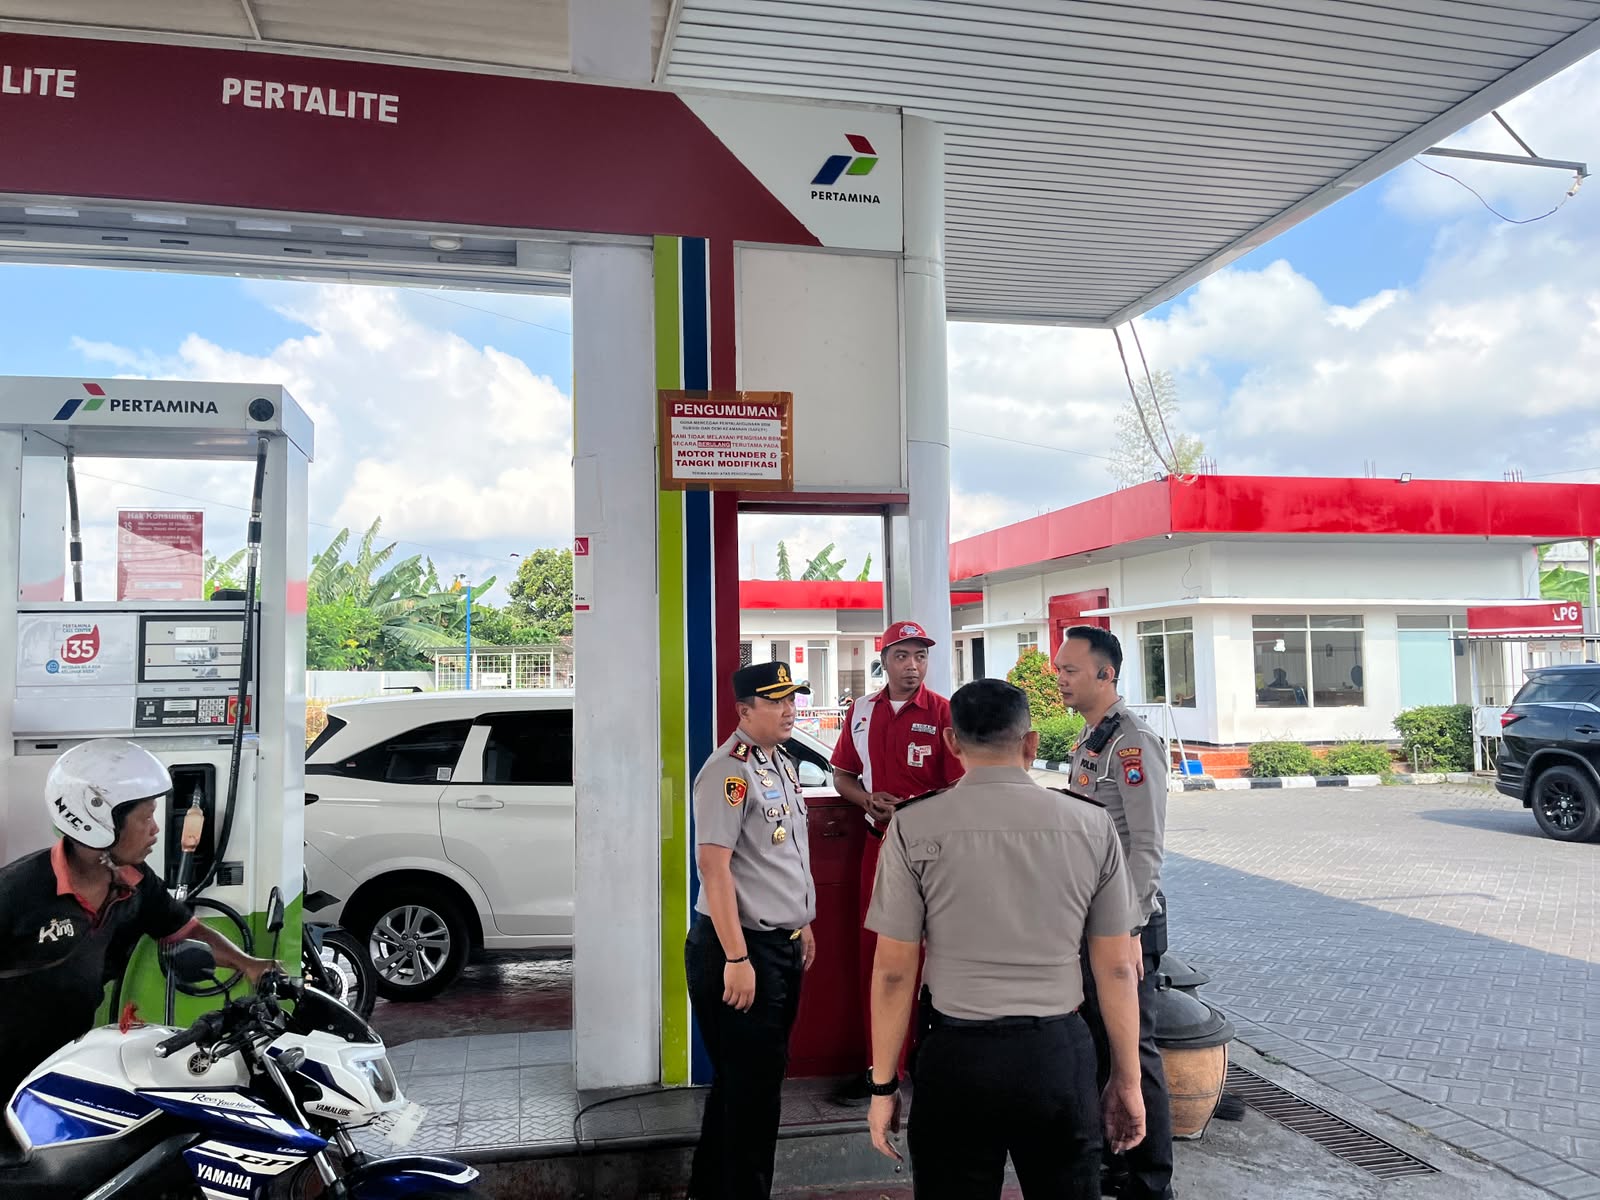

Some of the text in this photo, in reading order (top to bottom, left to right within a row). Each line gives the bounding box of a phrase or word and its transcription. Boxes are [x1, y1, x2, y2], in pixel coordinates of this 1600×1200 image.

[2, 65, 76, 98] LITE
[222, 77, 400, 124] PERTALITE
[811, 191, 880, 204] PERTAMINA
[110, 399, 219, 414] PERTAMINA
[674, 404, 778, 418] PENGUMUMAN
[1552, 606, 1578, 621] LPG
[63, 640, 94, 658] 135
[1080, 758, 1098, 772] POLRI
[38, 922, 74, 943] King
[316, 1104, 353, 1116] YAMALUBE
[197, 1163, 252, 1191] YAMAHA
